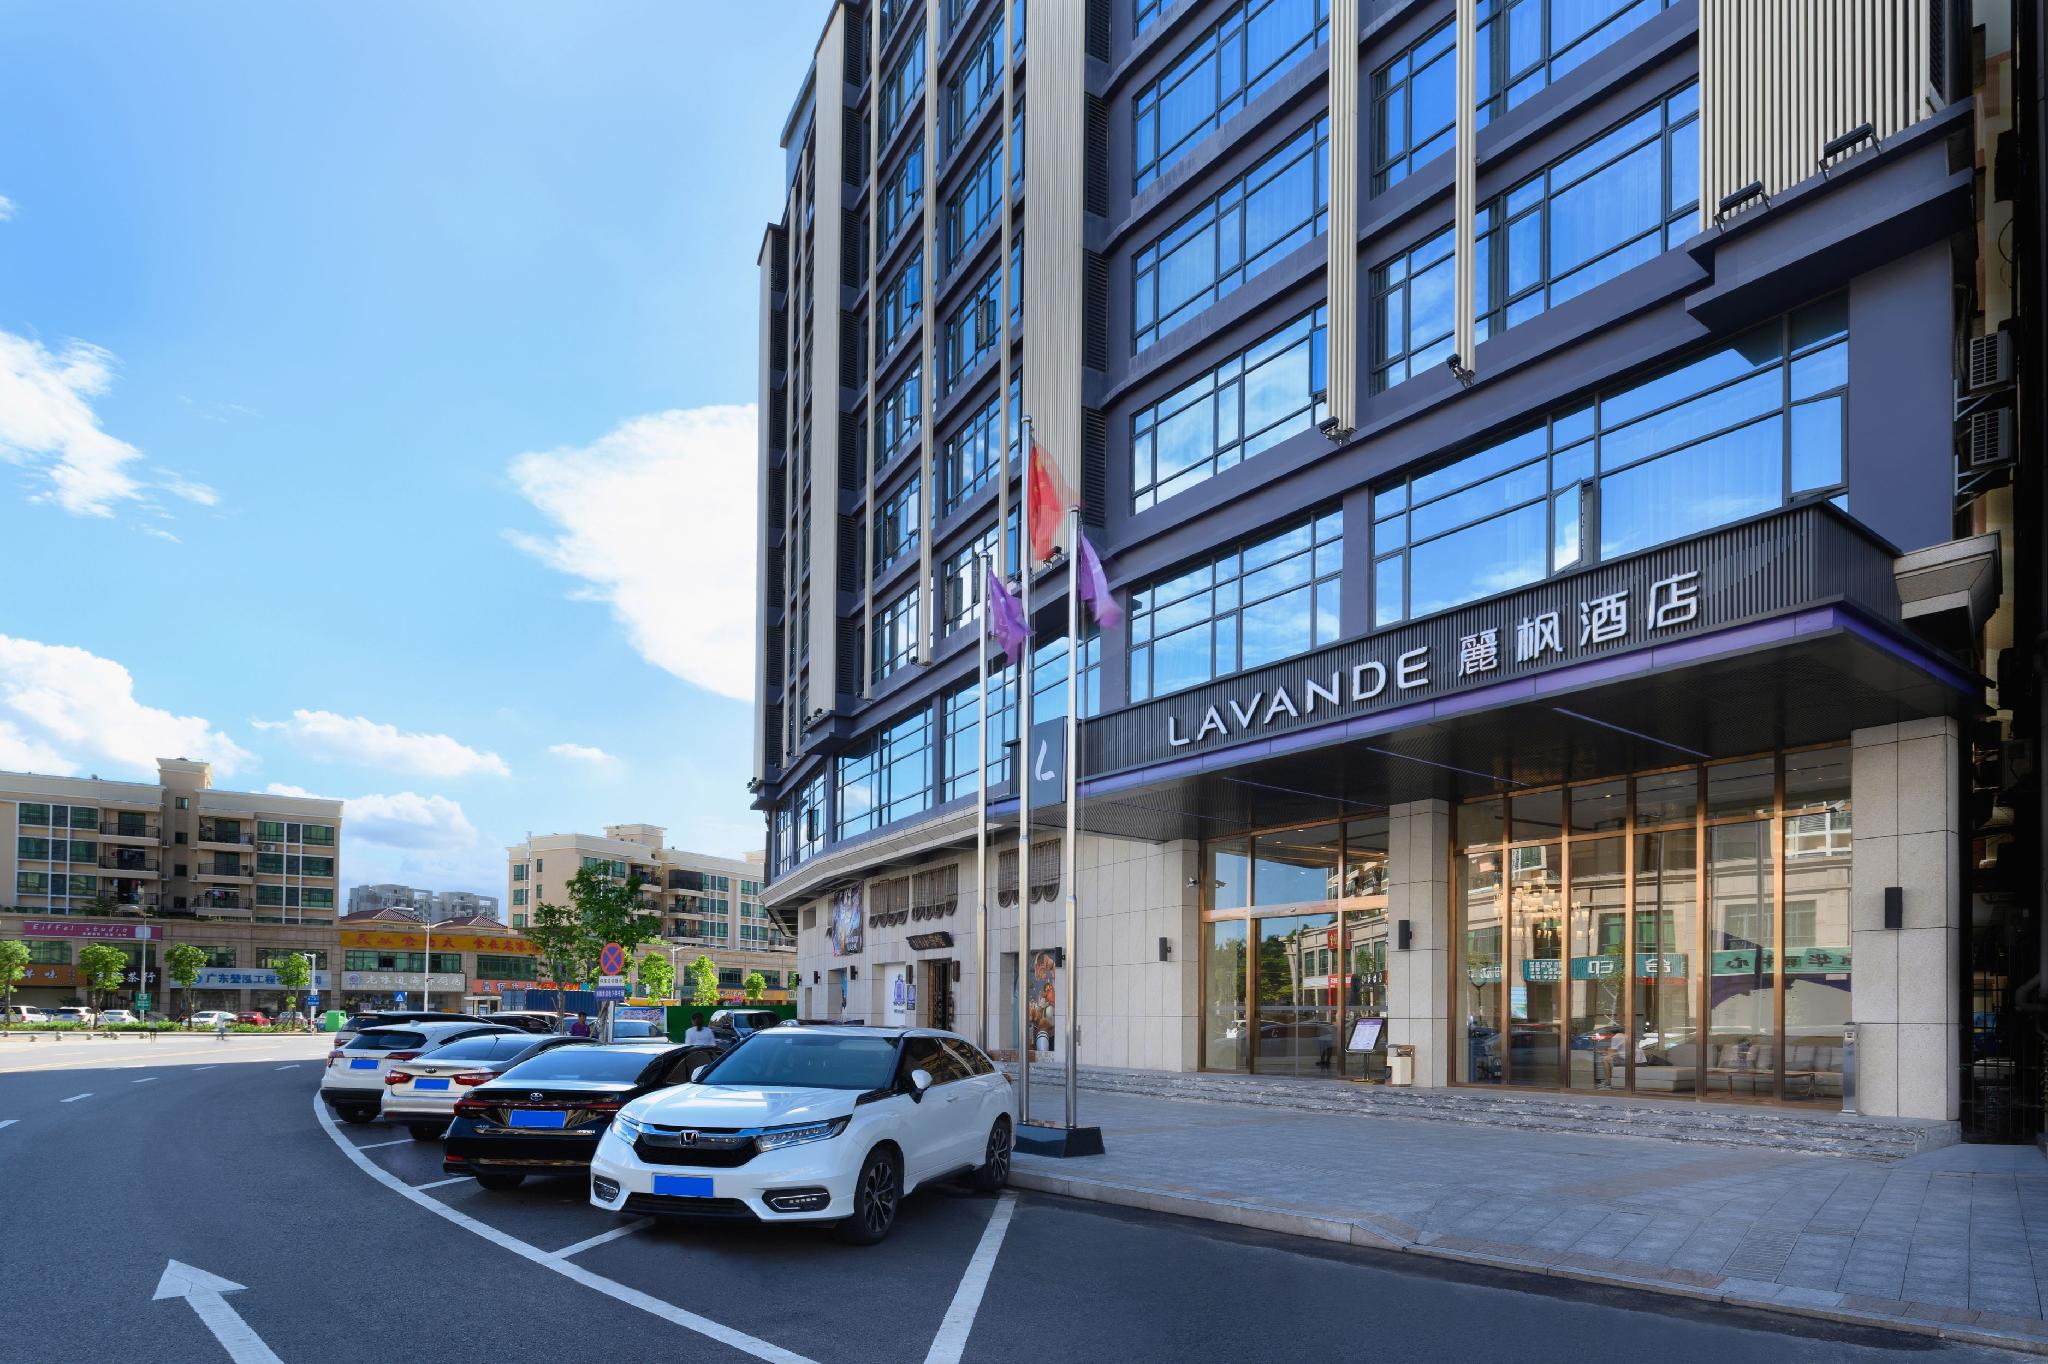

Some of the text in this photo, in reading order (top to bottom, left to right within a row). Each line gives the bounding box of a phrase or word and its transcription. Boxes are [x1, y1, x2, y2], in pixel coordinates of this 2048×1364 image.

[1168, 570, 1700, 747] LAVANDE 麗枫酒店
